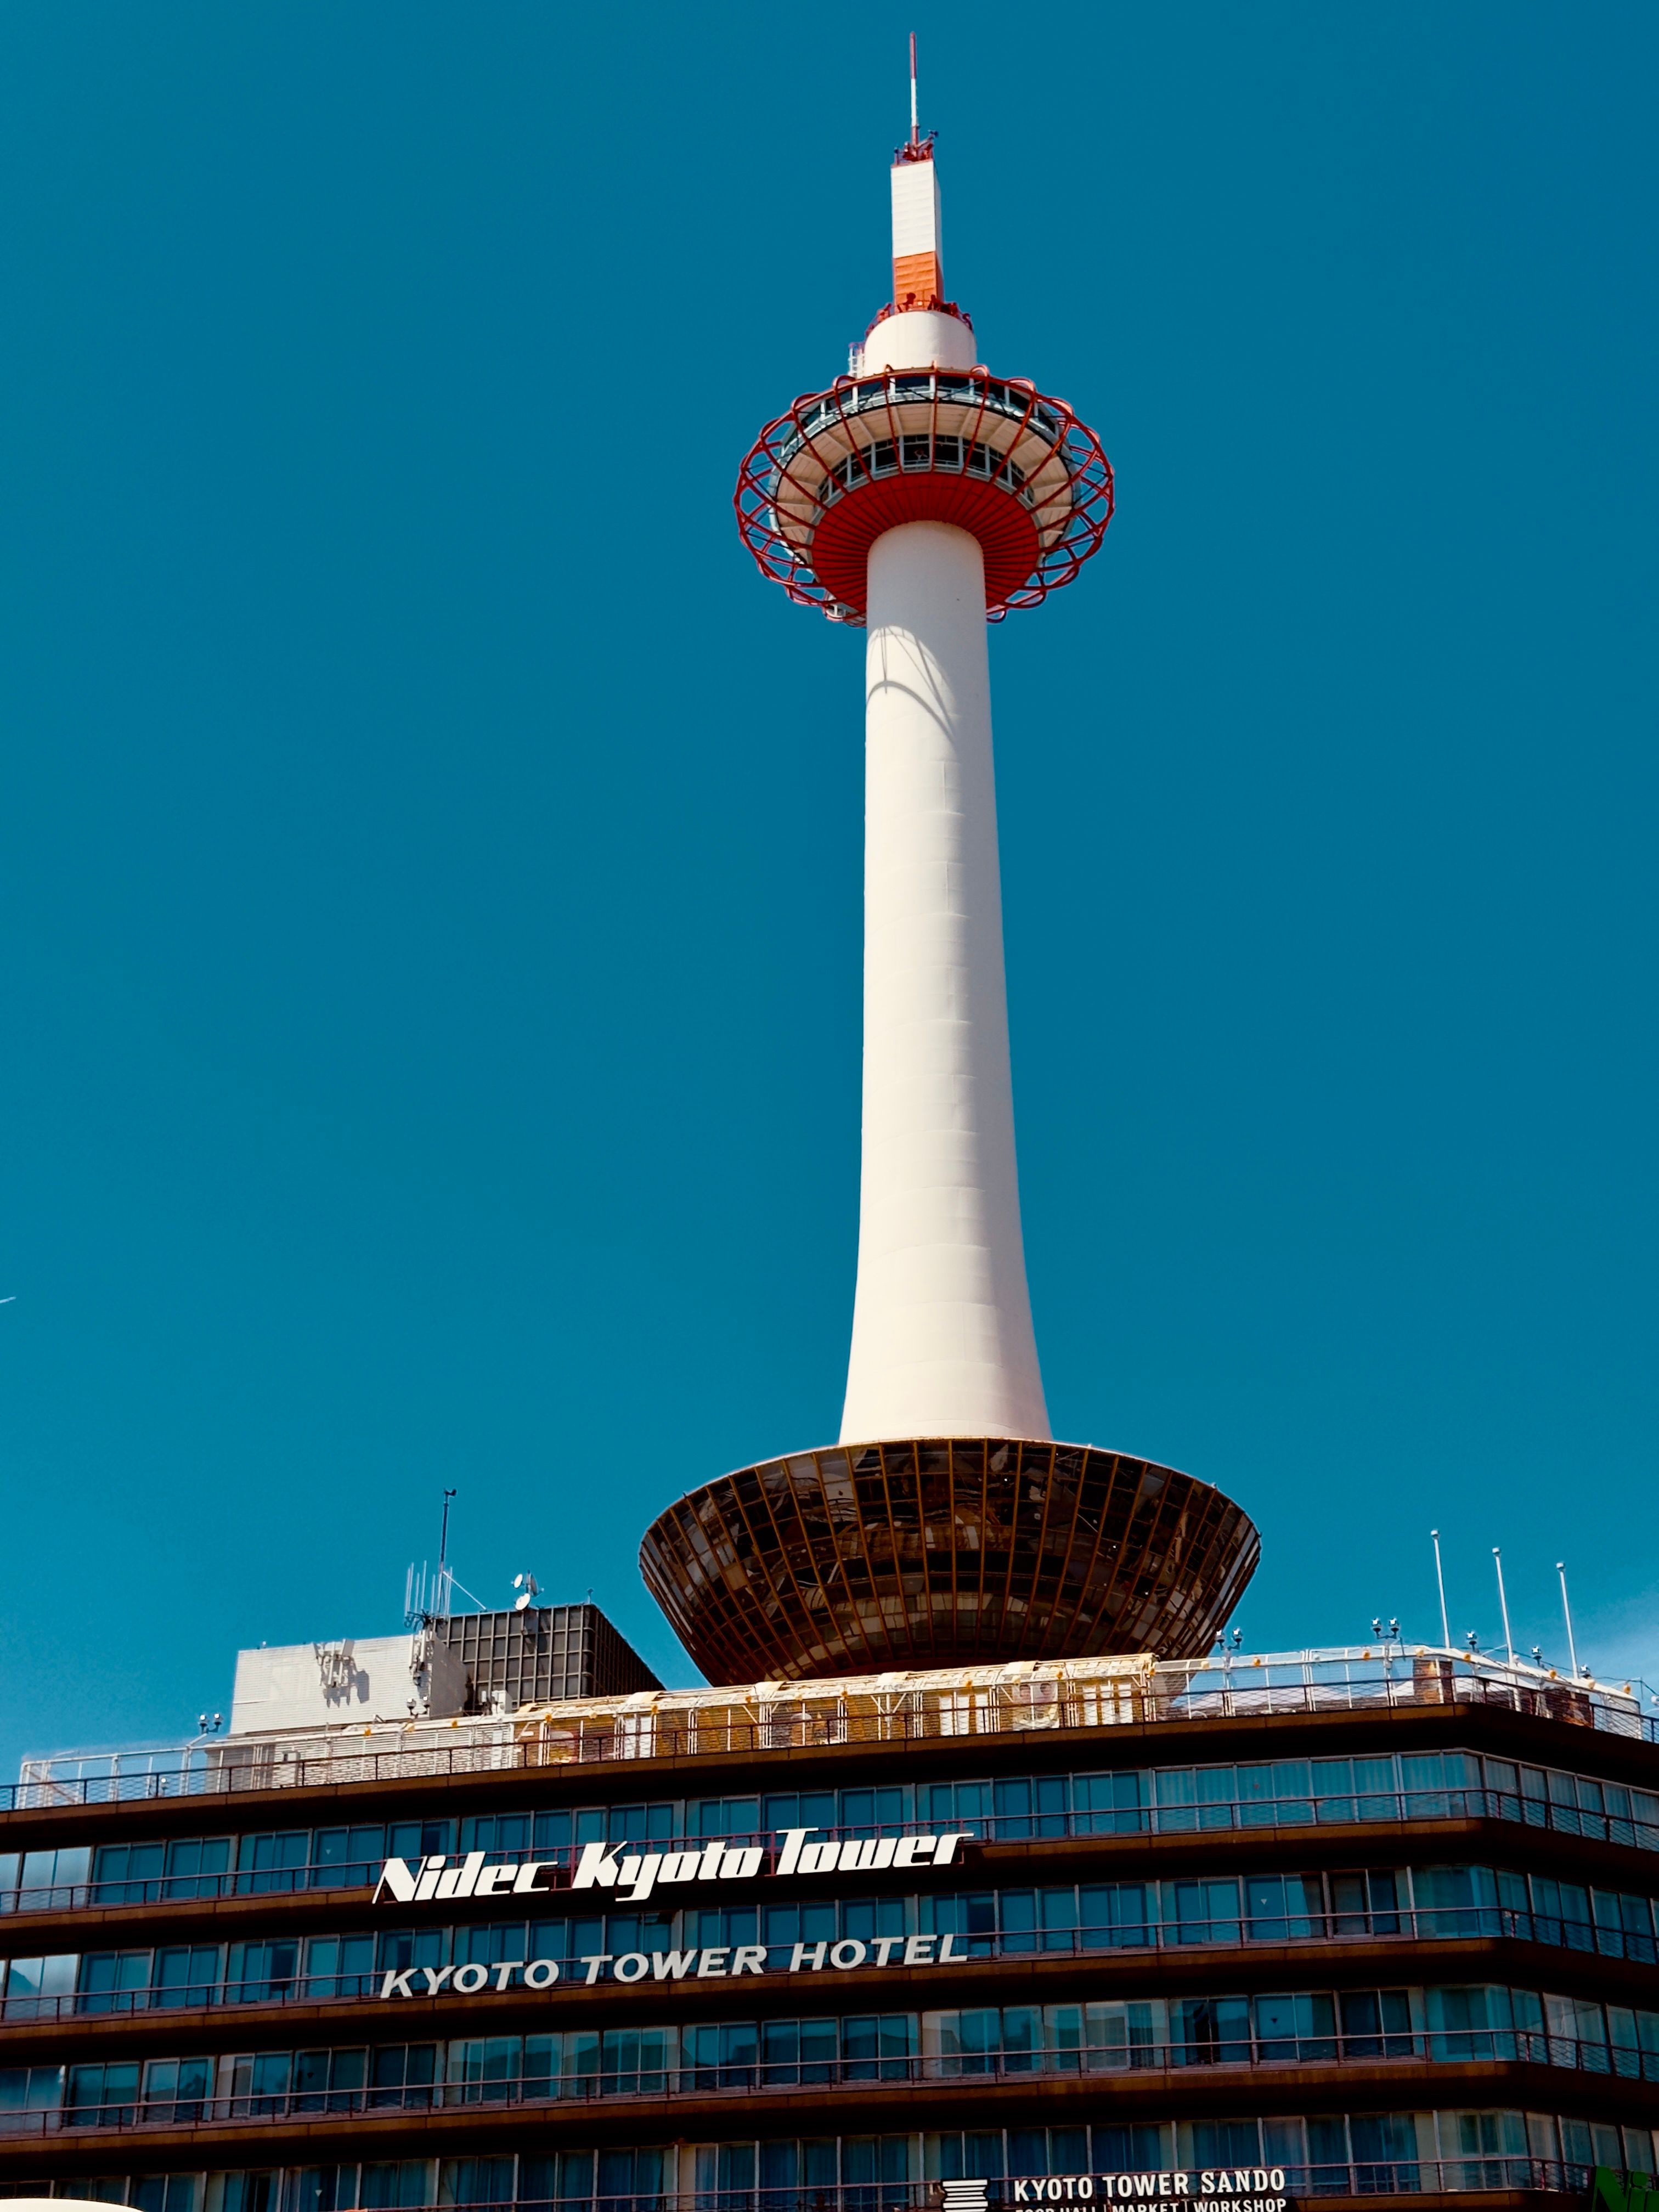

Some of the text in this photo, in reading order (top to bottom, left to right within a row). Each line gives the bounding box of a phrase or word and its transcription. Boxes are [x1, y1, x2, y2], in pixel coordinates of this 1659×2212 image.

[371, 1827, 975, 1905] Nidec Kyoto Tower
[379, 1934, 968, 1999] KYOTO TOWER HOTEL
[1014, 2168, 1285, 2202] KYOTO TOWER SANDO
[1193, 2198, 1286, 2212] WORKSHOP
